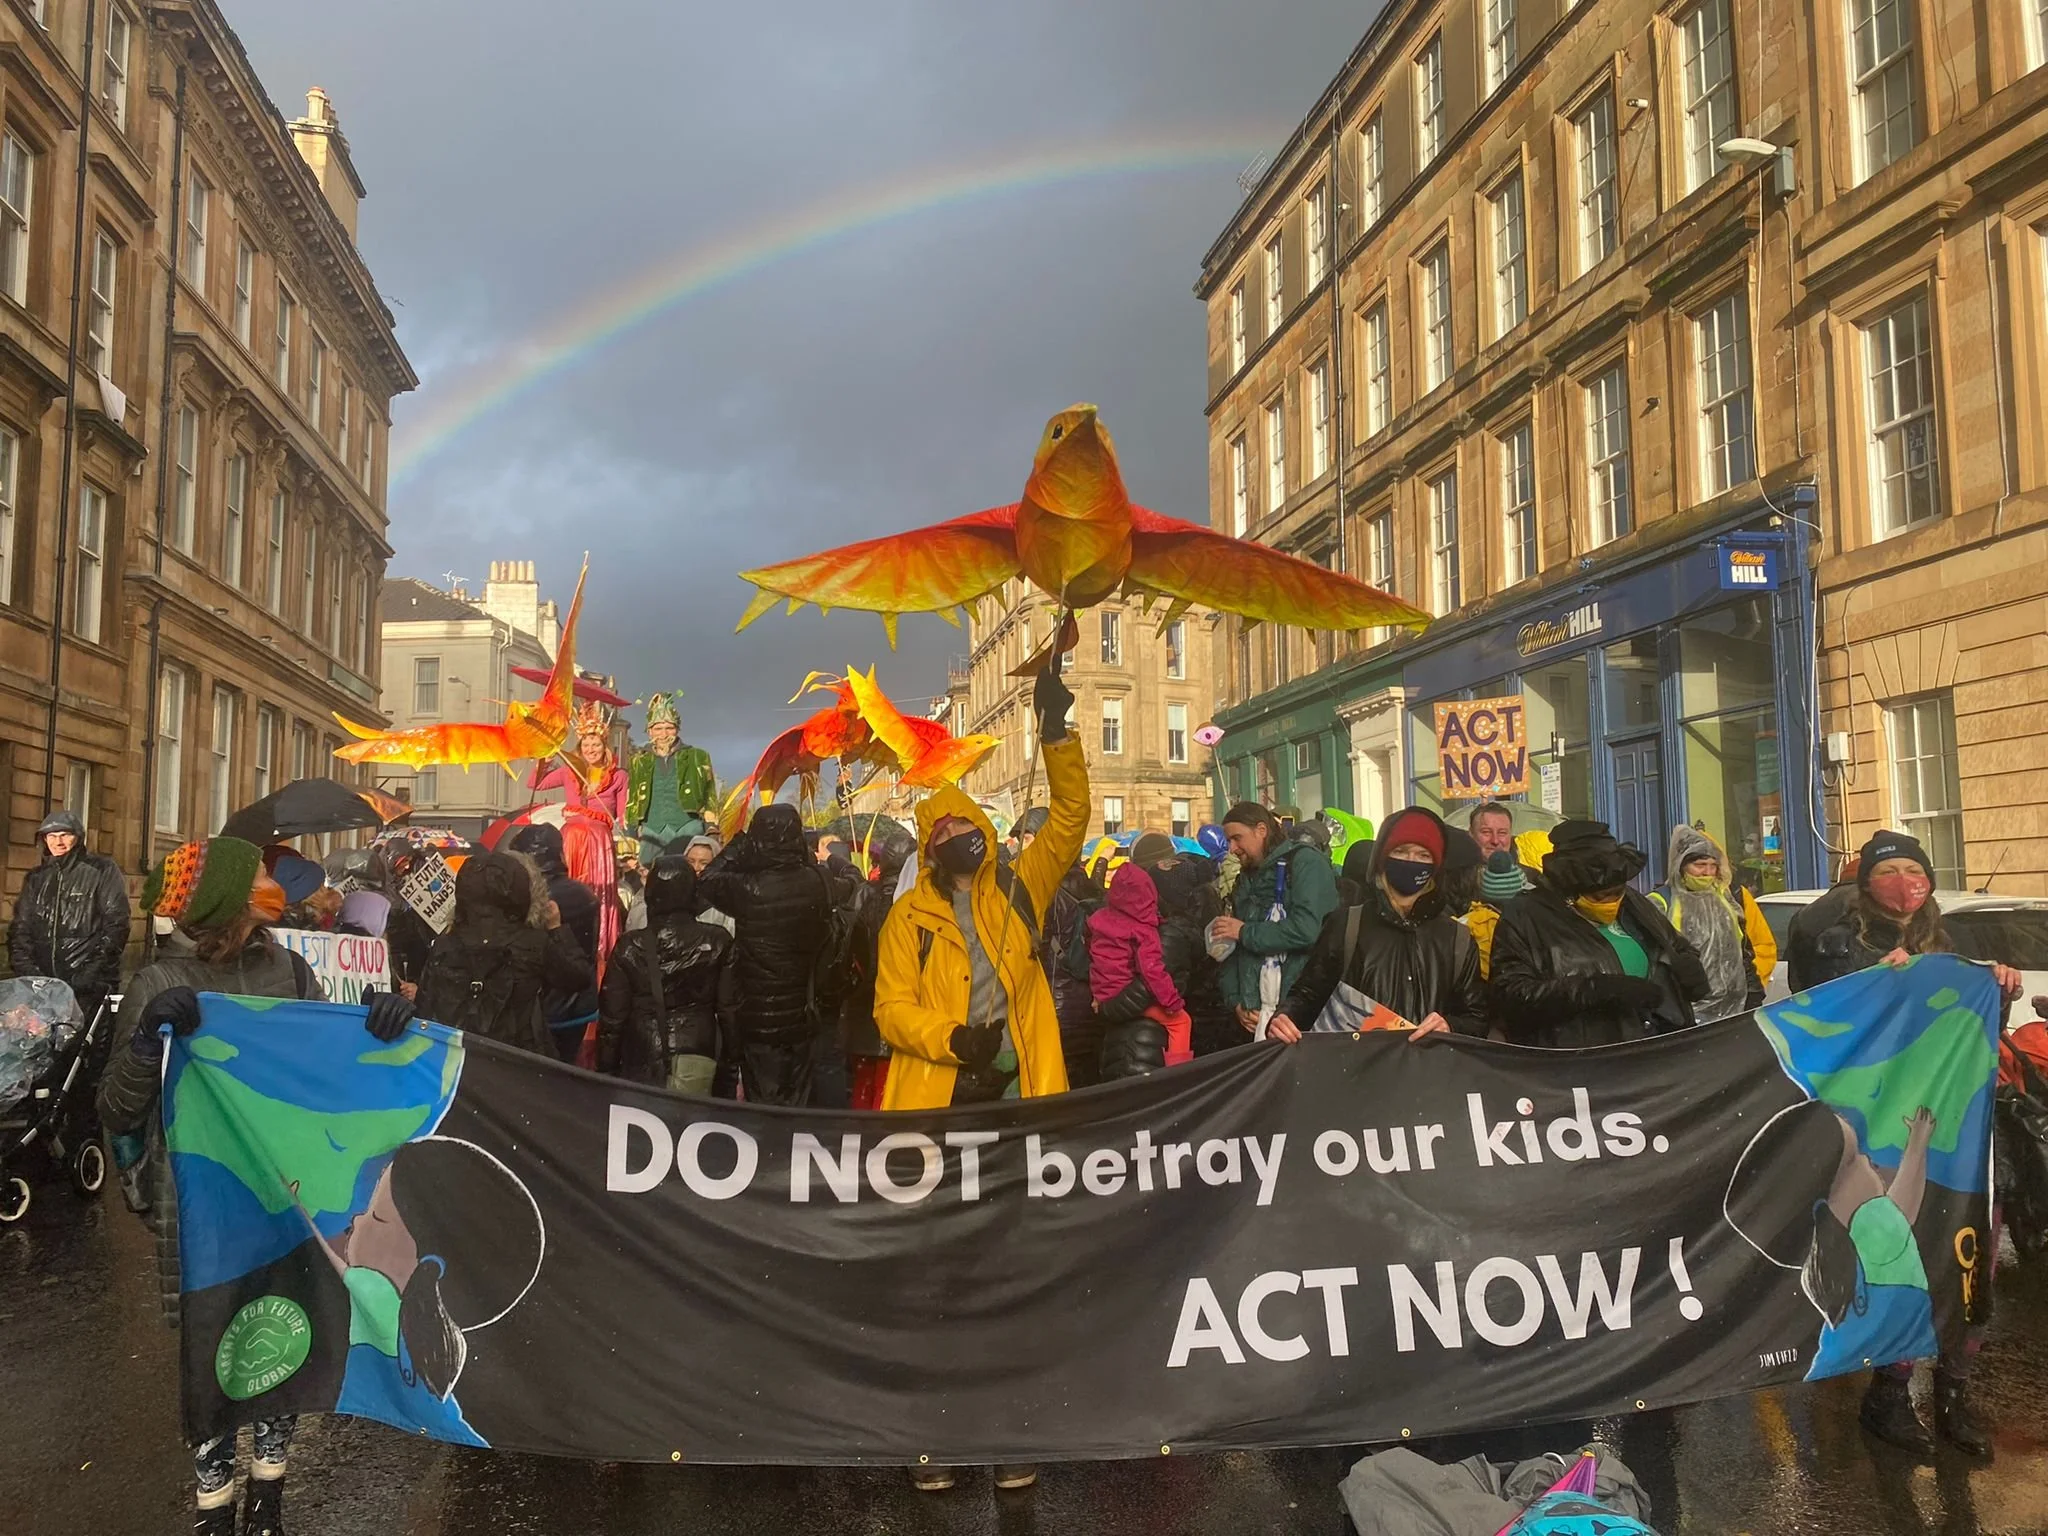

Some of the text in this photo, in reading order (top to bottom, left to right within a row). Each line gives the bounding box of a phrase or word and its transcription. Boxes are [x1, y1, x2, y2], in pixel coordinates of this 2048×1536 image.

[1732, 565, 1768, 583] HILL
[1517, 602, 1603, 657] William HILL
[1440, 705, 1521, 749] ACT
[1443, 746, 1525, 788] NOW
[402, 856, 443, 897] MY FUTURE
[413, 895, 423, 906] IN
[301, 937, 330, 968] EST
[338, 938, 384, 973] CHAUD
[607, 1087, 1670, 1206] DO NOT betray our kids.
[242, 1301, 264, 1322] FOR
[270, 1301, 305, 1336] FUTURE
[1167, 1266, 1360, 1368] ACT
[1387, 1246, 1642, 1352] NOW
[248, 1363, 295, 1393] GLOBAL
